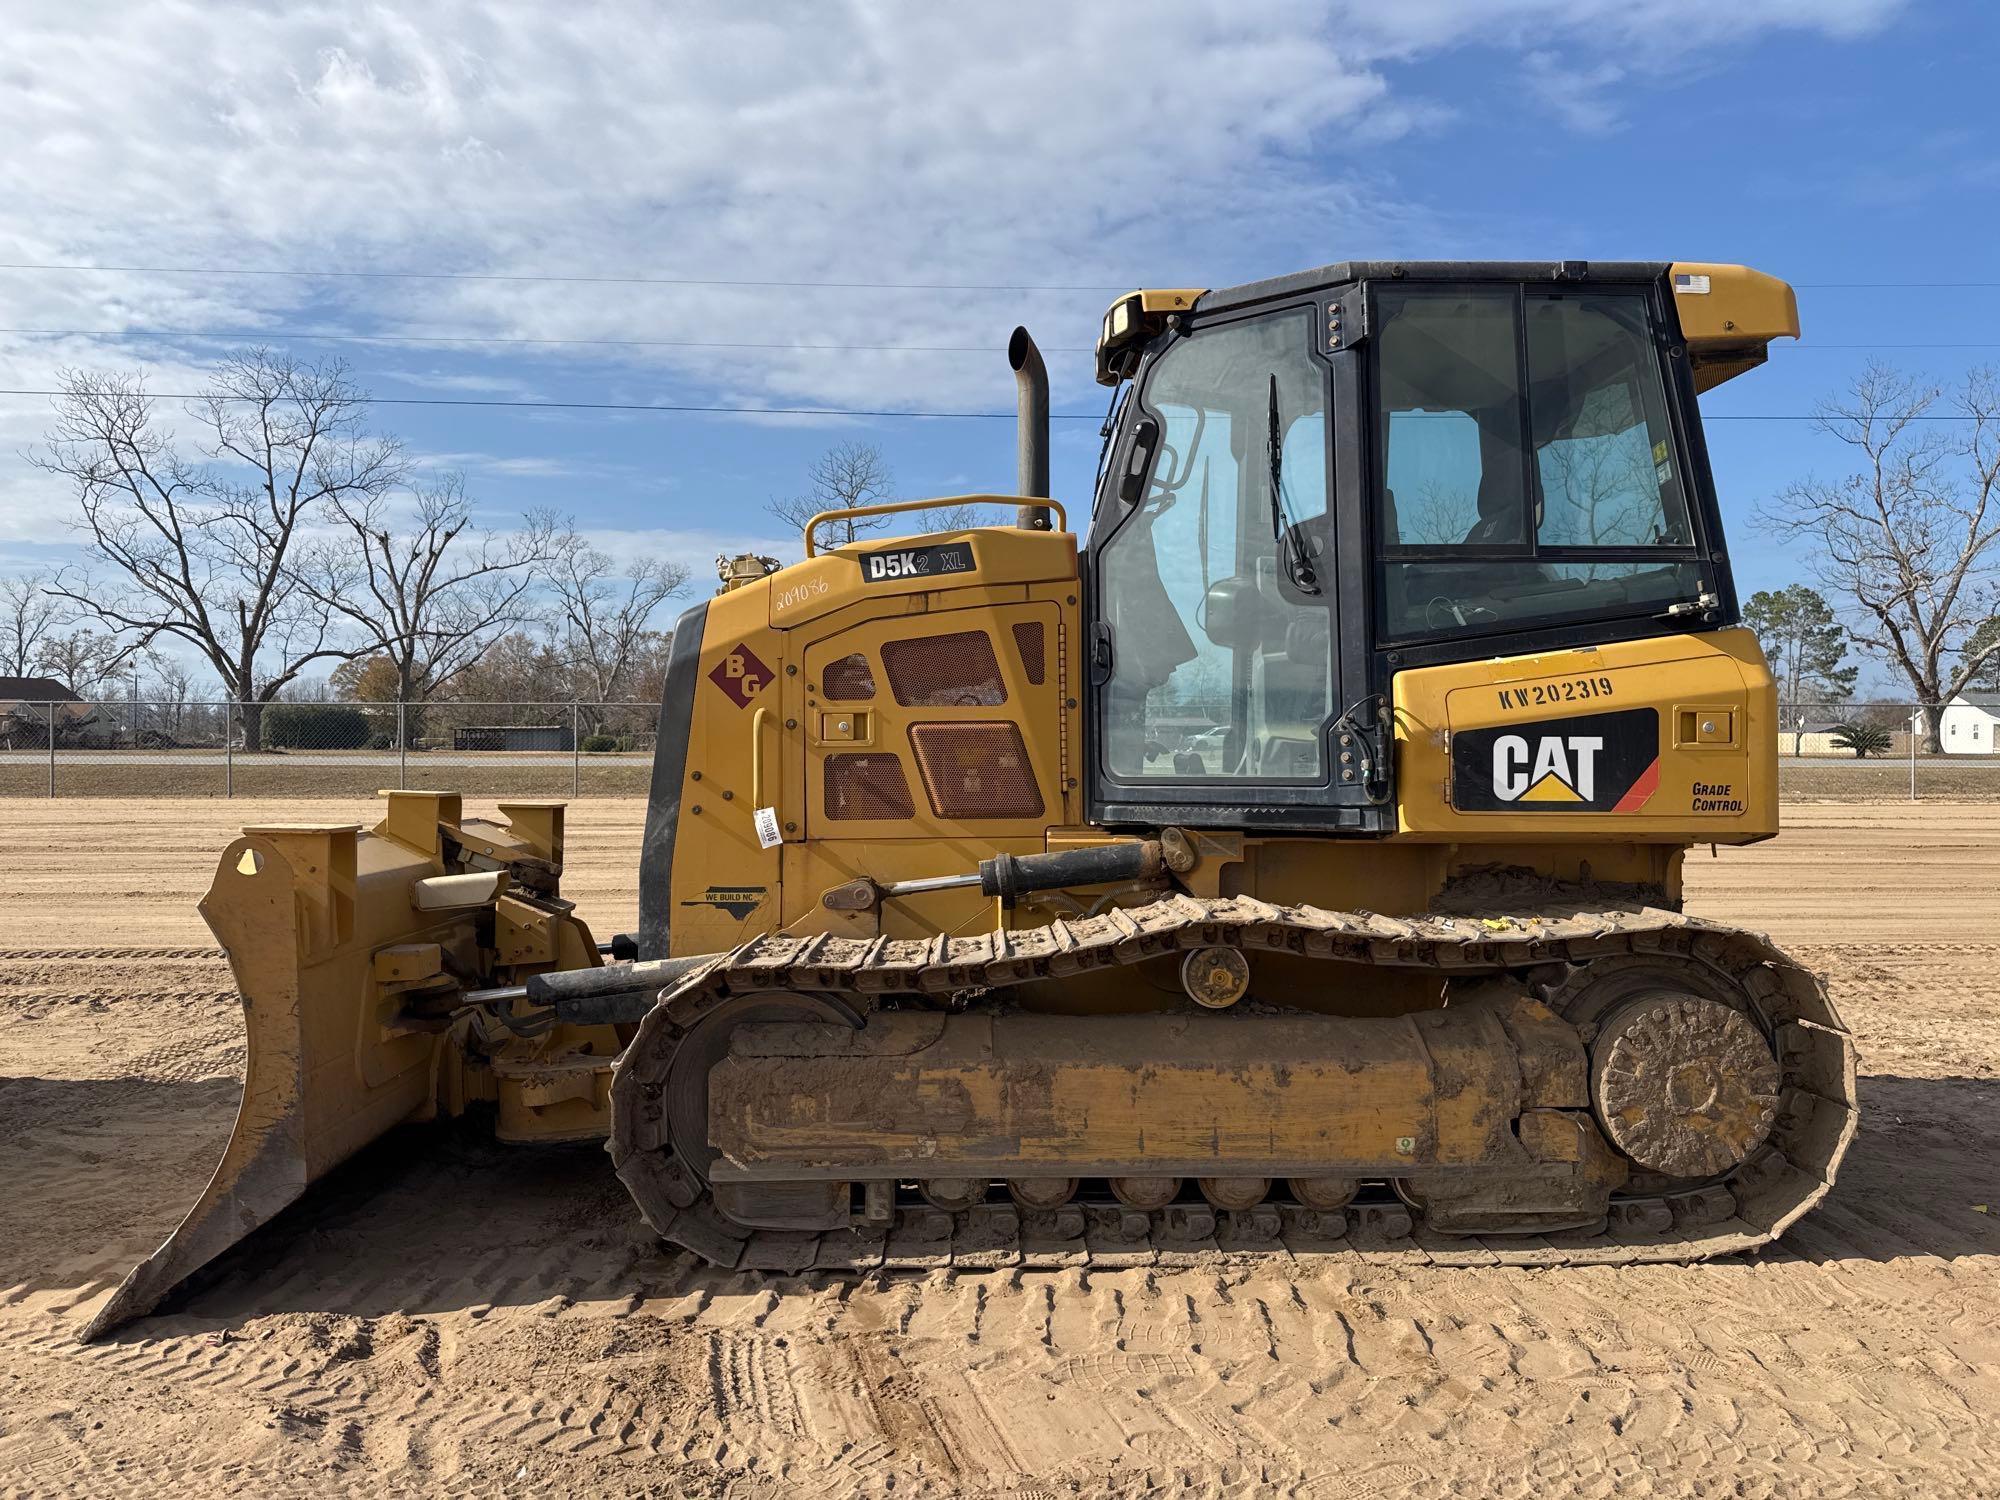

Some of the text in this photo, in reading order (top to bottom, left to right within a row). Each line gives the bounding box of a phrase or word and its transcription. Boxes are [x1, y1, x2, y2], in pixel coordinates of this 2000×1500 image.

[939, 552, 966, 571] XL
[776, 576, 828, 610] 209086
[1498, 677, 1613, 710] KW202319
[1493, 735, 1603, 801] CAT
[762, 814, 777, 842] 209086
[705, 893, 753, 901] WE BUILD NC
